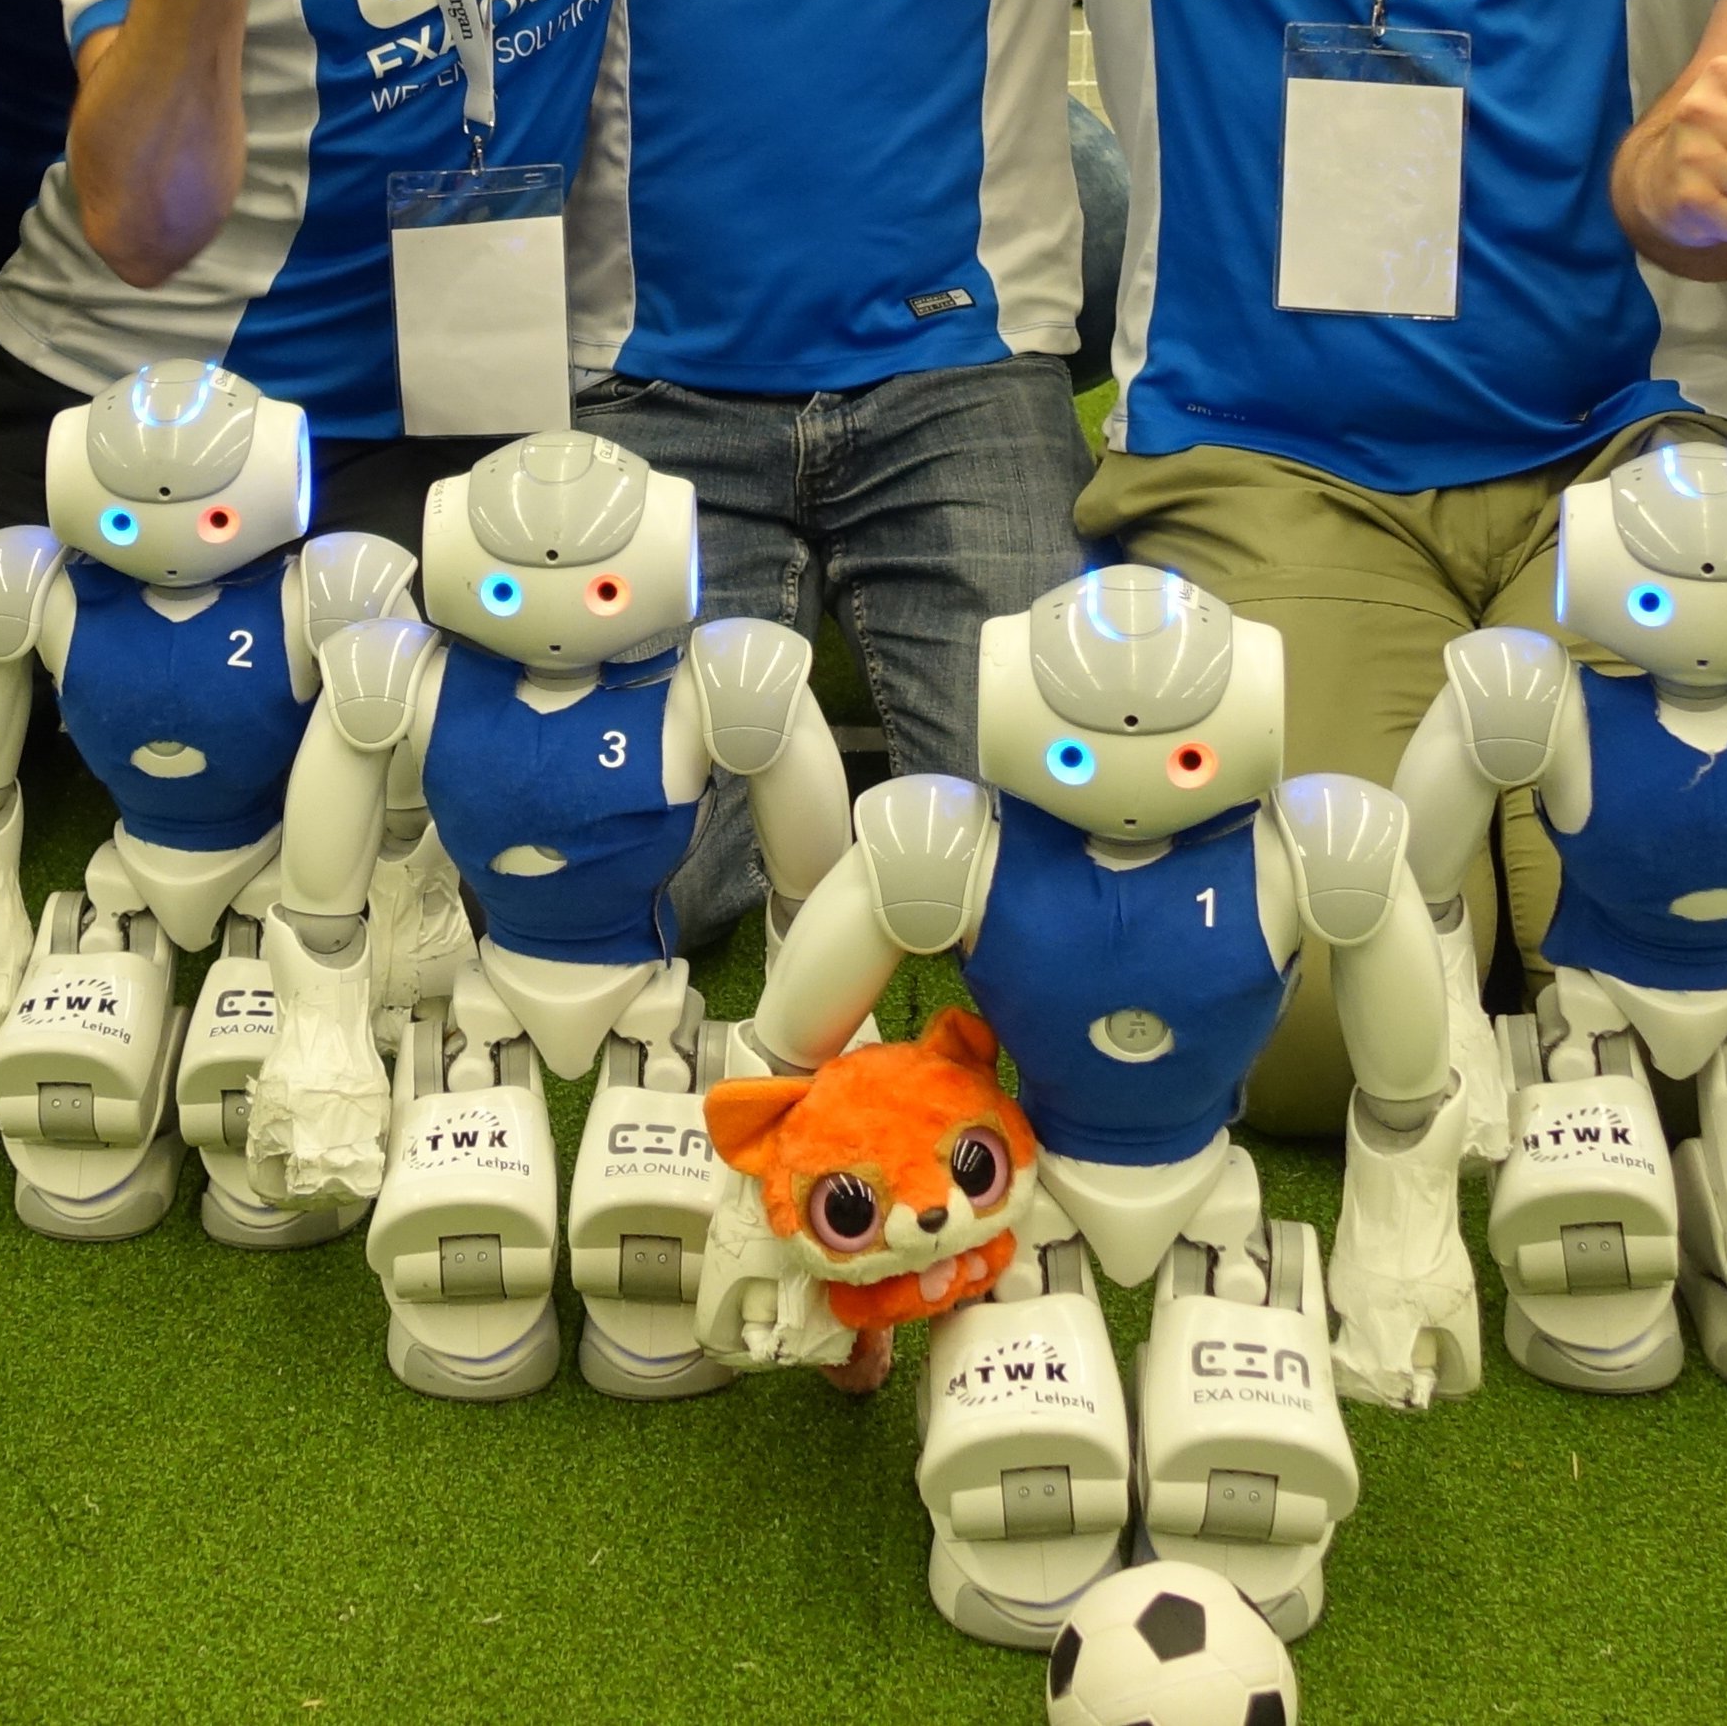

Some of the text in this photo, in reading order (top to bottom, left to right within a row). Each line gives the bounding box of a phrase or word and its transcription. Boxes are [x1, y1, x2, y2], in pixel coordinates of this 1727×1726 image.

[227, 630, 254, 668] 2
[598, 730, 627, 769] 3
[1196, 887, 1215, 928] 1
[18, 995, 118, 1017] HTWK
[81, 1020, 131, 1044] Leipzig
[209, 1023, 275, 1038] EXA ONL
[1523, 1127, 1632, 1152] HTWK
[476, 1156, 530, 1176] Leipzig
[604, 1162, 711, 1182] EXA ONLINE
[1602, 1152, 1656, 1175] Leipzig
[1034, 1389, 1096, 1413] Leipzig
[1193, 1387, 1314, 1413] EXA ONLINE
